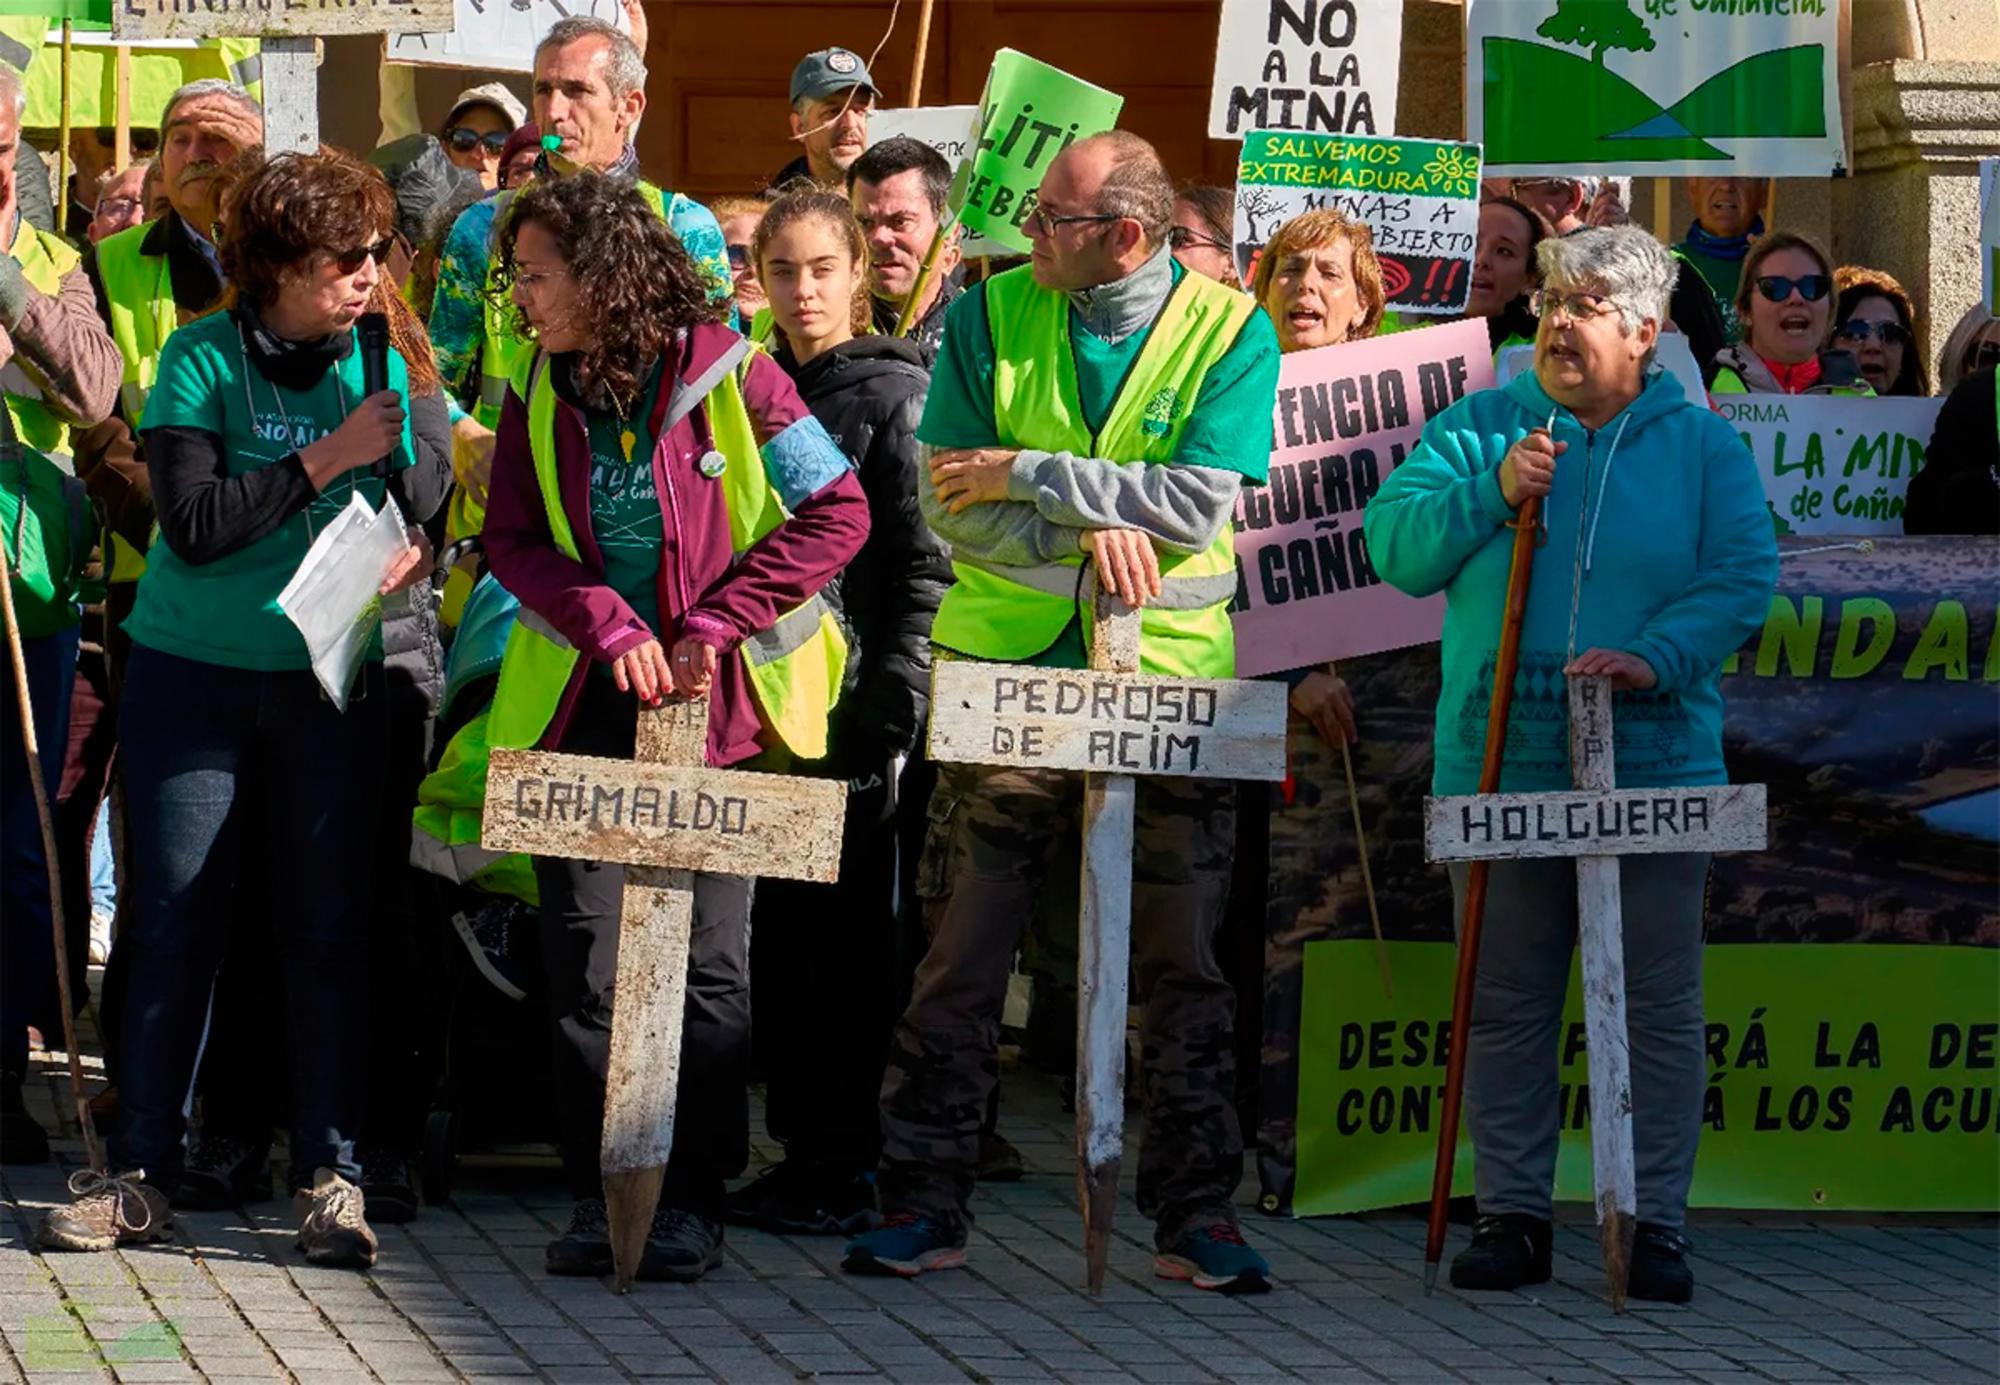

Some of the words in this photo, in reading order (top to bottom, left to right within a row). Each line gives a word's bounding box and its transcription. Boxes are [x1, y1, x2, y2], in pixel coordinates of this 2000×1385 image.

[1268, 0, 1357, 47] NO
[1262, 50, 1286, 83] A
[1309, 51, 1360, 86] LA
[1226, 86, 1376, 135] MINA
[1265, 137, 1401, 164] SALVEMOS
[1238, 161, 1428, 192] EXTREMADURA
[1303, 192, 1411, 222] MINAS
[1430, 202, 1455, 224] A
[1272, 369, 1410, 452] ENCIA
[1718, 403, 1790, 423] ORMA
[1774, 431, 1824, 480] LA
[1842, 431, 1928, 478] MIN
[1231, 447, 1380, 533] GUERA
[1790, 485, 1823, 521] de
[1832, 484, 1905, 520] Caña
[1258, 519, 1380, 606] CAÑA
[1722, 594, 2000, 682] NDA
[994, 677, 1217, 727] PEDROSO
[992, 725, 1044, 756] DE
[850, 773, 882, 792] ILA
[1462, 796, 1709, 842] HOLGUERA
[1814, 1022, 1881, 1068] LA
[1754, 1085, 1852, 1132] LOS
[1879, 1086, 2000, 1133] ACU
